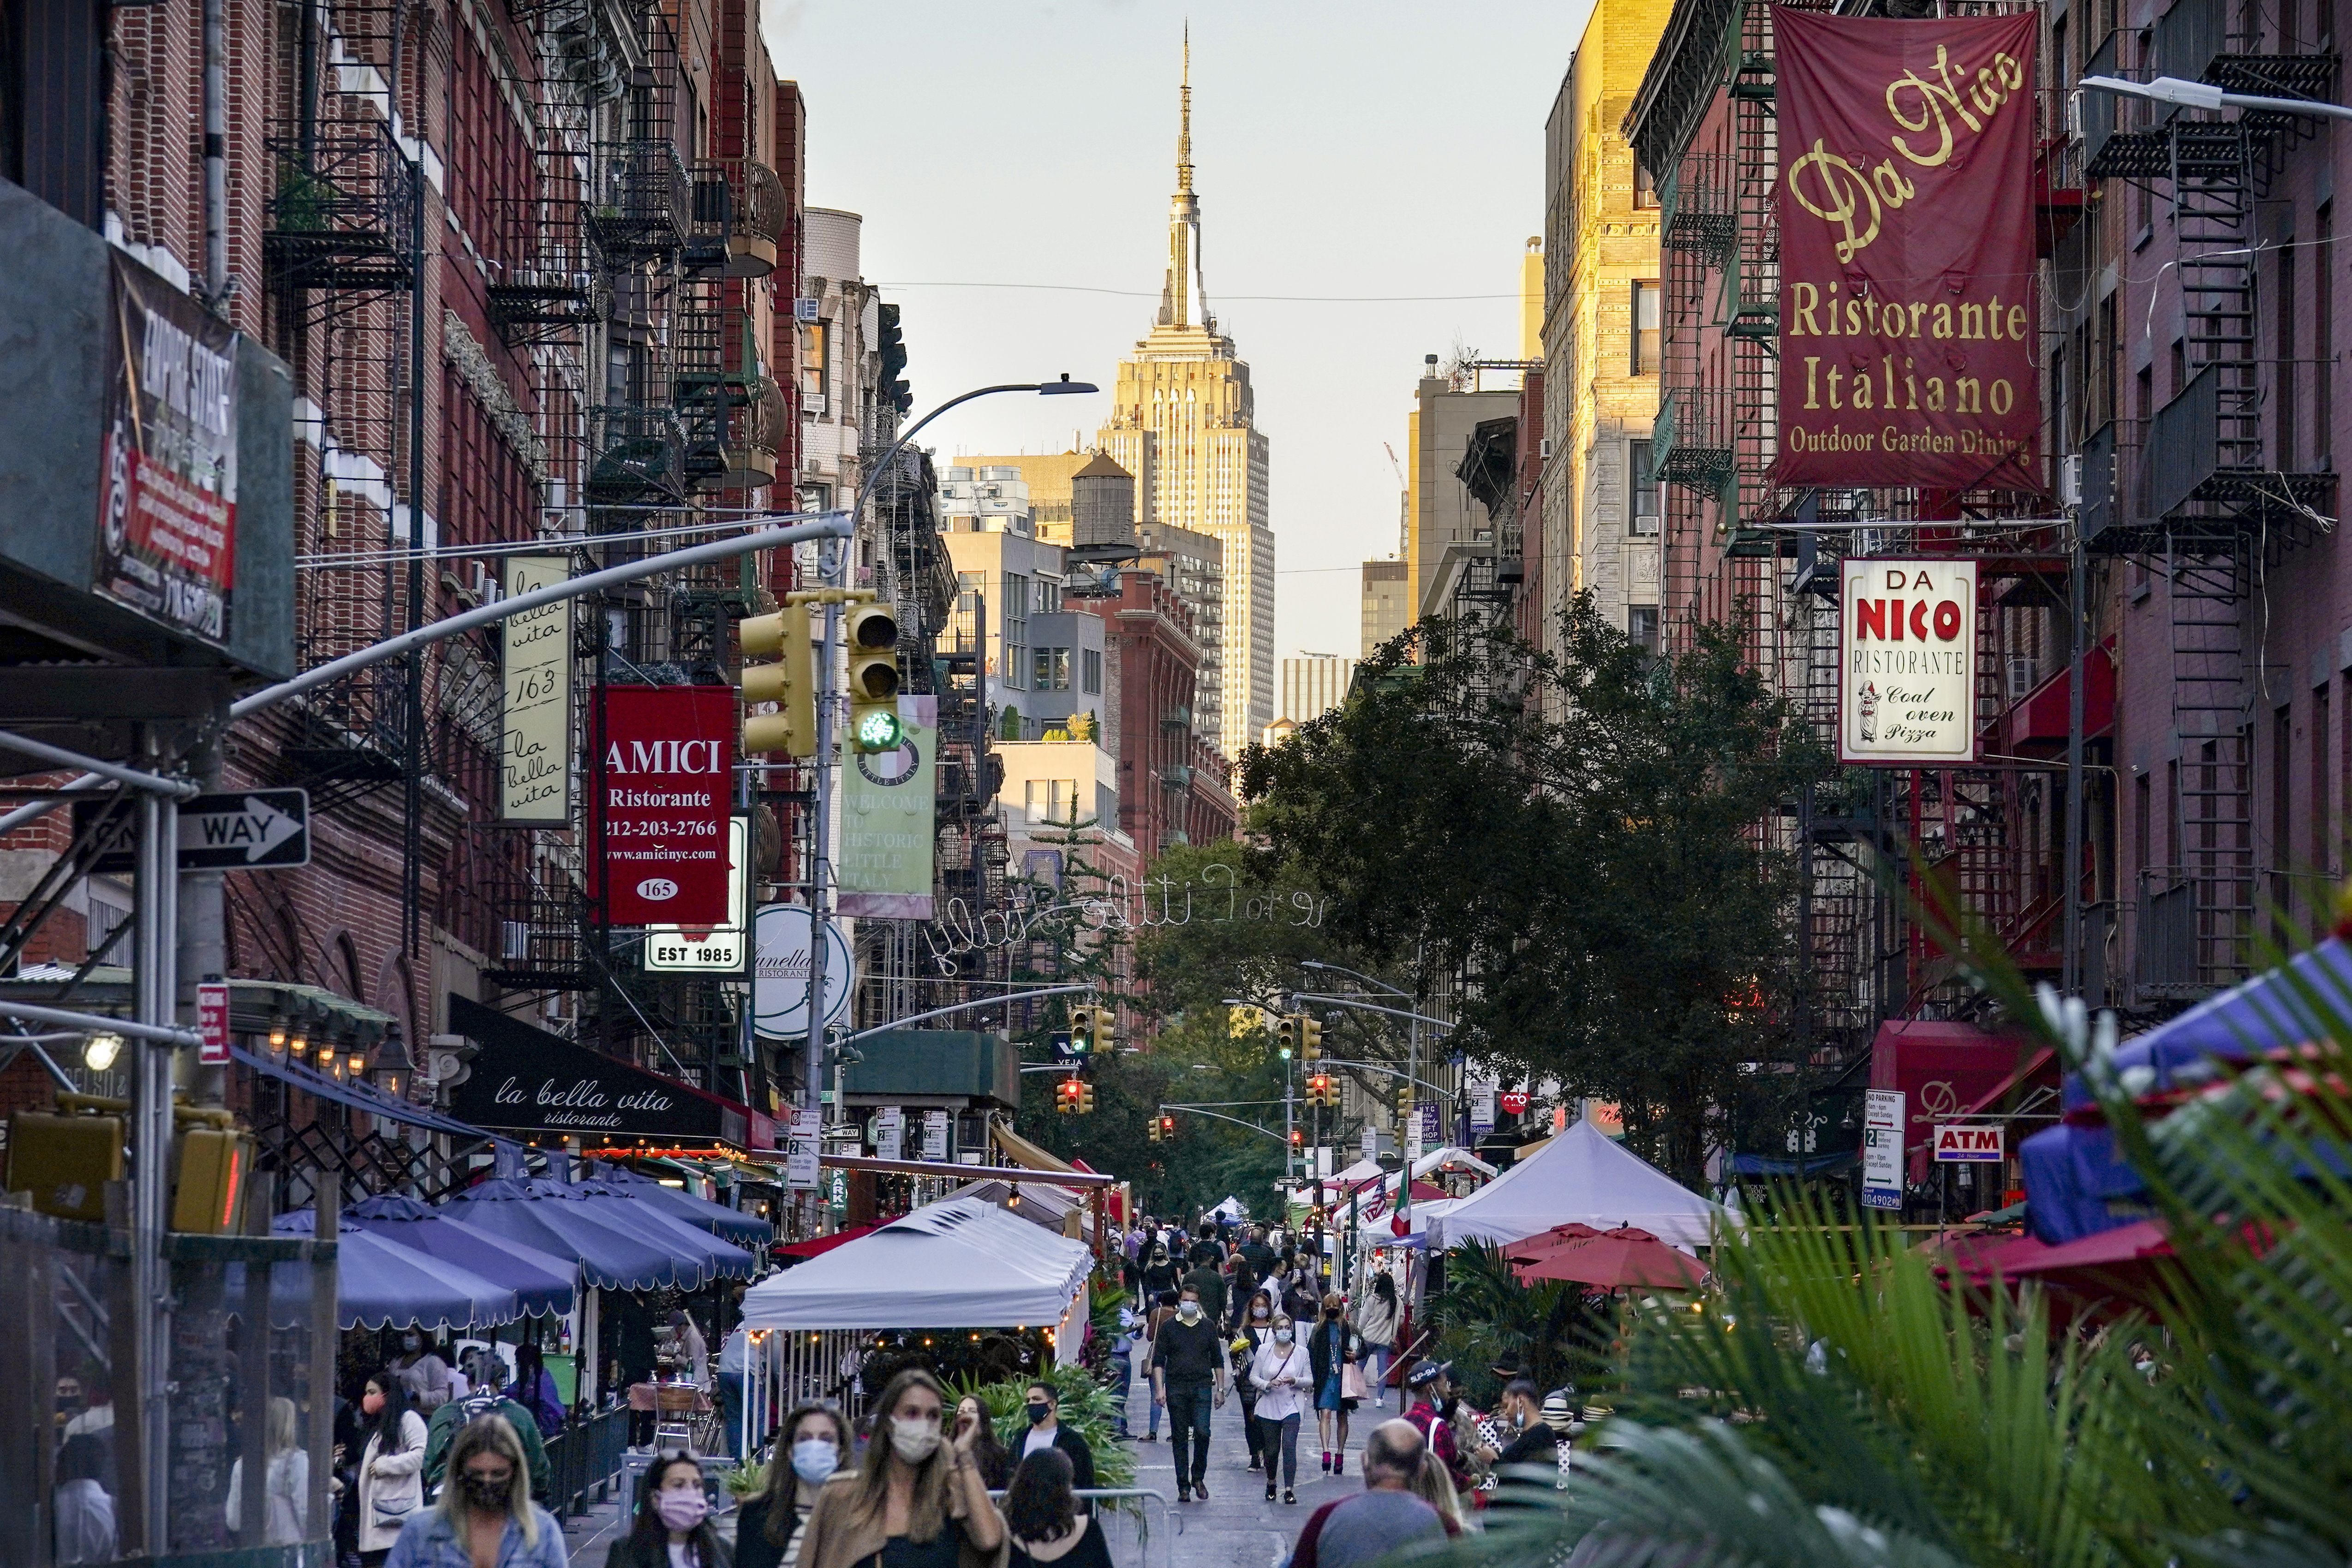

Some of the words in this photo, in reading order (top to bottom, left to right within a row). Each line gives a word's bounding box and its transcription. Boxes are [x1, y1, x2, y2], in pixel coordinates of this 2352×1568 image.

[1789, 138, 1915, 264] Da
[1886, 44, 2023, 167] Nico
[1789, 281, 2027, 341] Ristorante
[1803, 354, 2013, 415] Italiano
[1790, 425, 1874, 453] Outdoor
[1882, 426, 1955, 454] Garden
[1961, 429, 2031, 466] Dining
[1886, 570, 1933, 591] DA
[1857, 599, 1961, 643] NICO
[513, 625, 561, 647] vita
[1854, 650, 1963, 675] RISTORANTE
[516, 669, 554, 704] 163
[1886, 686, 1935, 704] Coal
[1906, 710, 1955, 722] oven
[515, 731, 547, 757] la
[1885, 724, 1937, 744] Pizza
[606, 740, 722, 774] AMICI
[508, 756, 562, 788] bella
[859, 761, 890, 786] LITTLE
[895, 760, 918, 785] ITALY
[511, 785, 561, 808] vita
[609, 788, 711, 807] Ristorante
[844, 795, 929, 810] WELCOME
[202, 815, 274, 845] WAY
[845, 815, 864, 828] TO
[845, 833, 923, 848] HISTORIC
[845, 854, 901, 869] LITTLE
[645, 882, 671, 897] 165
[845, 873, 892, 888] ITALY
[658, 948, 687, 961] EST
[697, 948, 732, 962] 1985
[755, 945, 812, 969] unella
[495, 1076, 527, 1104] la
[537, 1078, 609, 1107] bella
[617, 1089, 674, 1111] vita
[1876, 1094, 1895, 1103] PARKING
[544, 1110, 622, 1127] ristorante
[879, 1131, 884, 1140] 2
[1868, 1130, 1874, 1145] 2
[1939, 1131, 1999, 1149] ATM
[791, 1142, 797, 1154] 2
[833, 1170, 844, 1203] PARK
